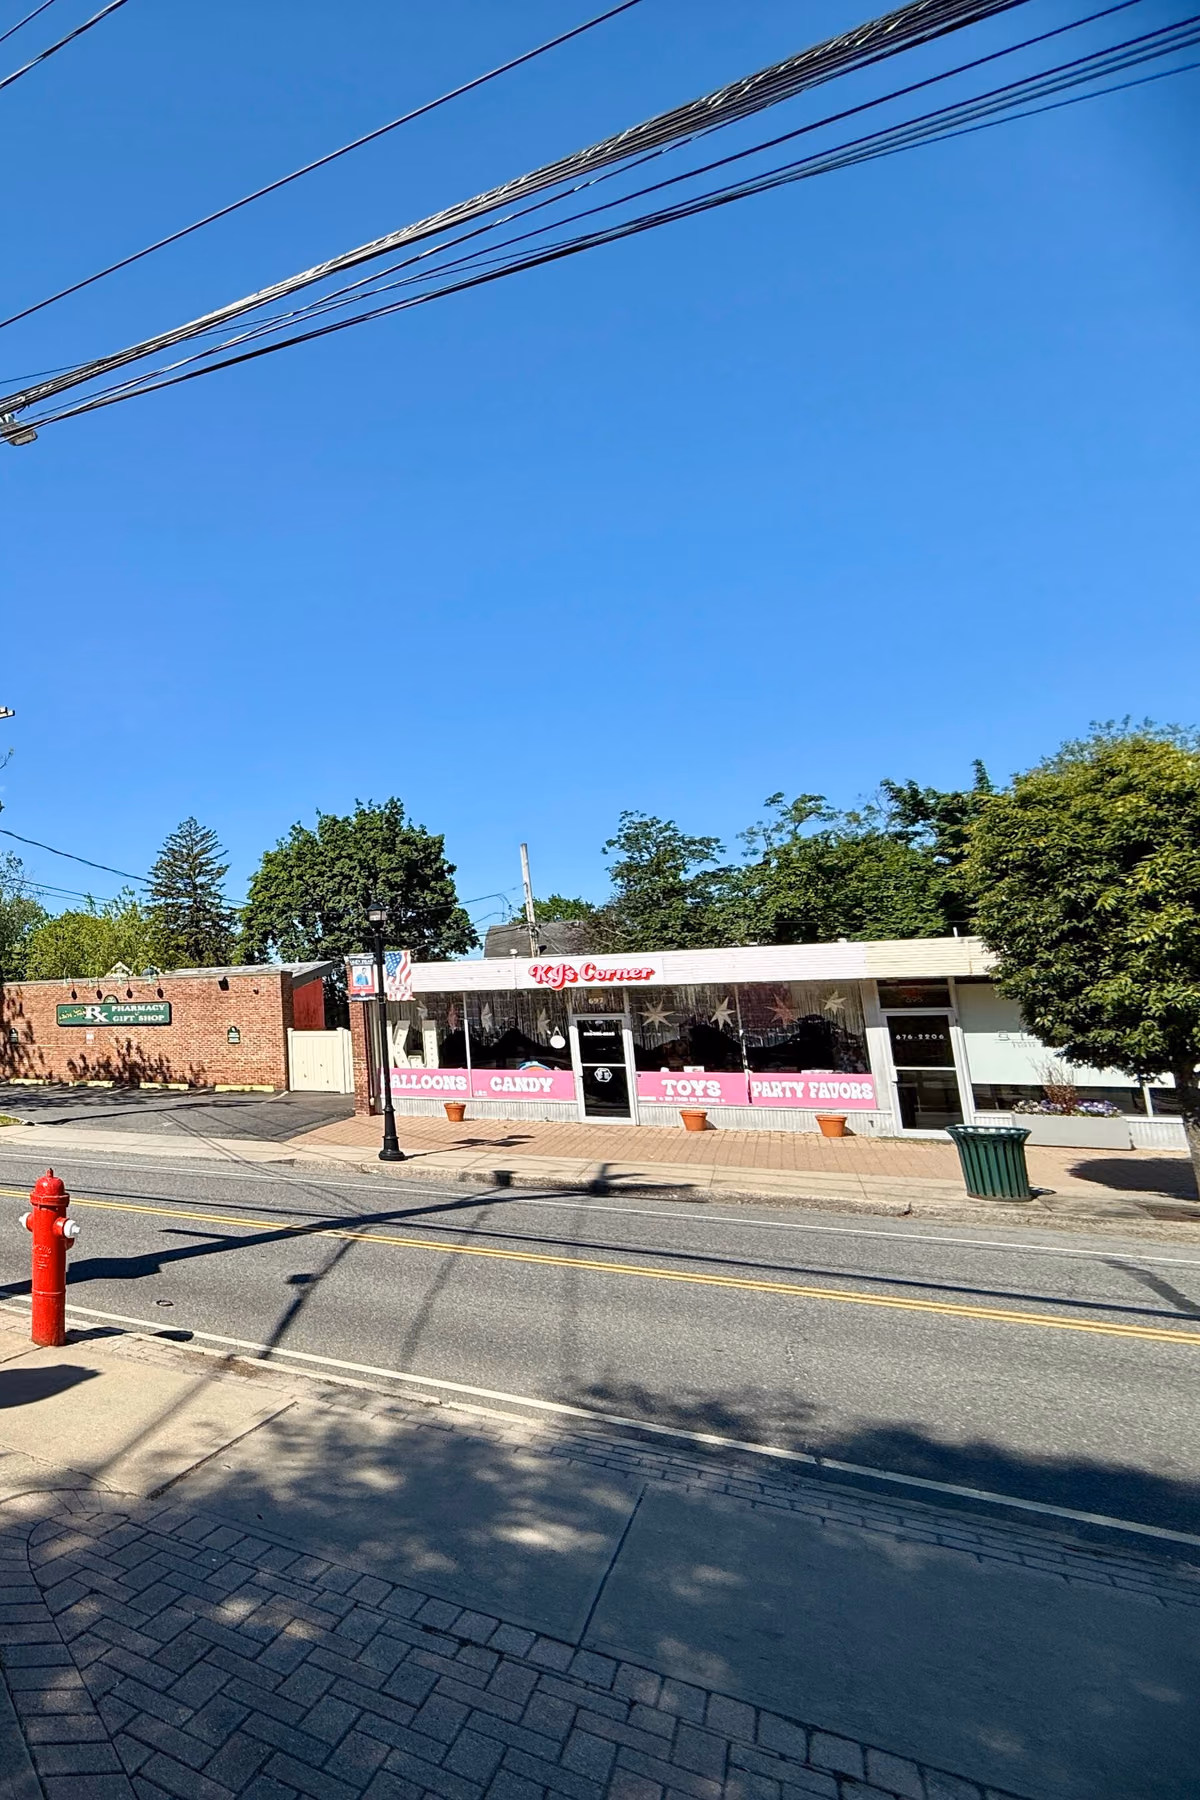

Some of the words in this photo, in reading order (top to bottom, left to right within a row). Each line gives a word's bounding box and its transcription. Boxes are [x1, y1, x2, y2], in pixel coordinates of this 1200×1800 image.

[528, 963, 579, 990] KJ's
[580, 962, 656, 982] Corner
[84, 1006, 109, 1022] Rx
[112, 1004, 166, 1012] PHARMACY
[391, 1074, 468, 1091] ALLOONS
[490, 1076, 554, 1093] CANDY
[661, 1079, 722, 1097] TOYS
[751, 1081, 805, 1098] PARTY
